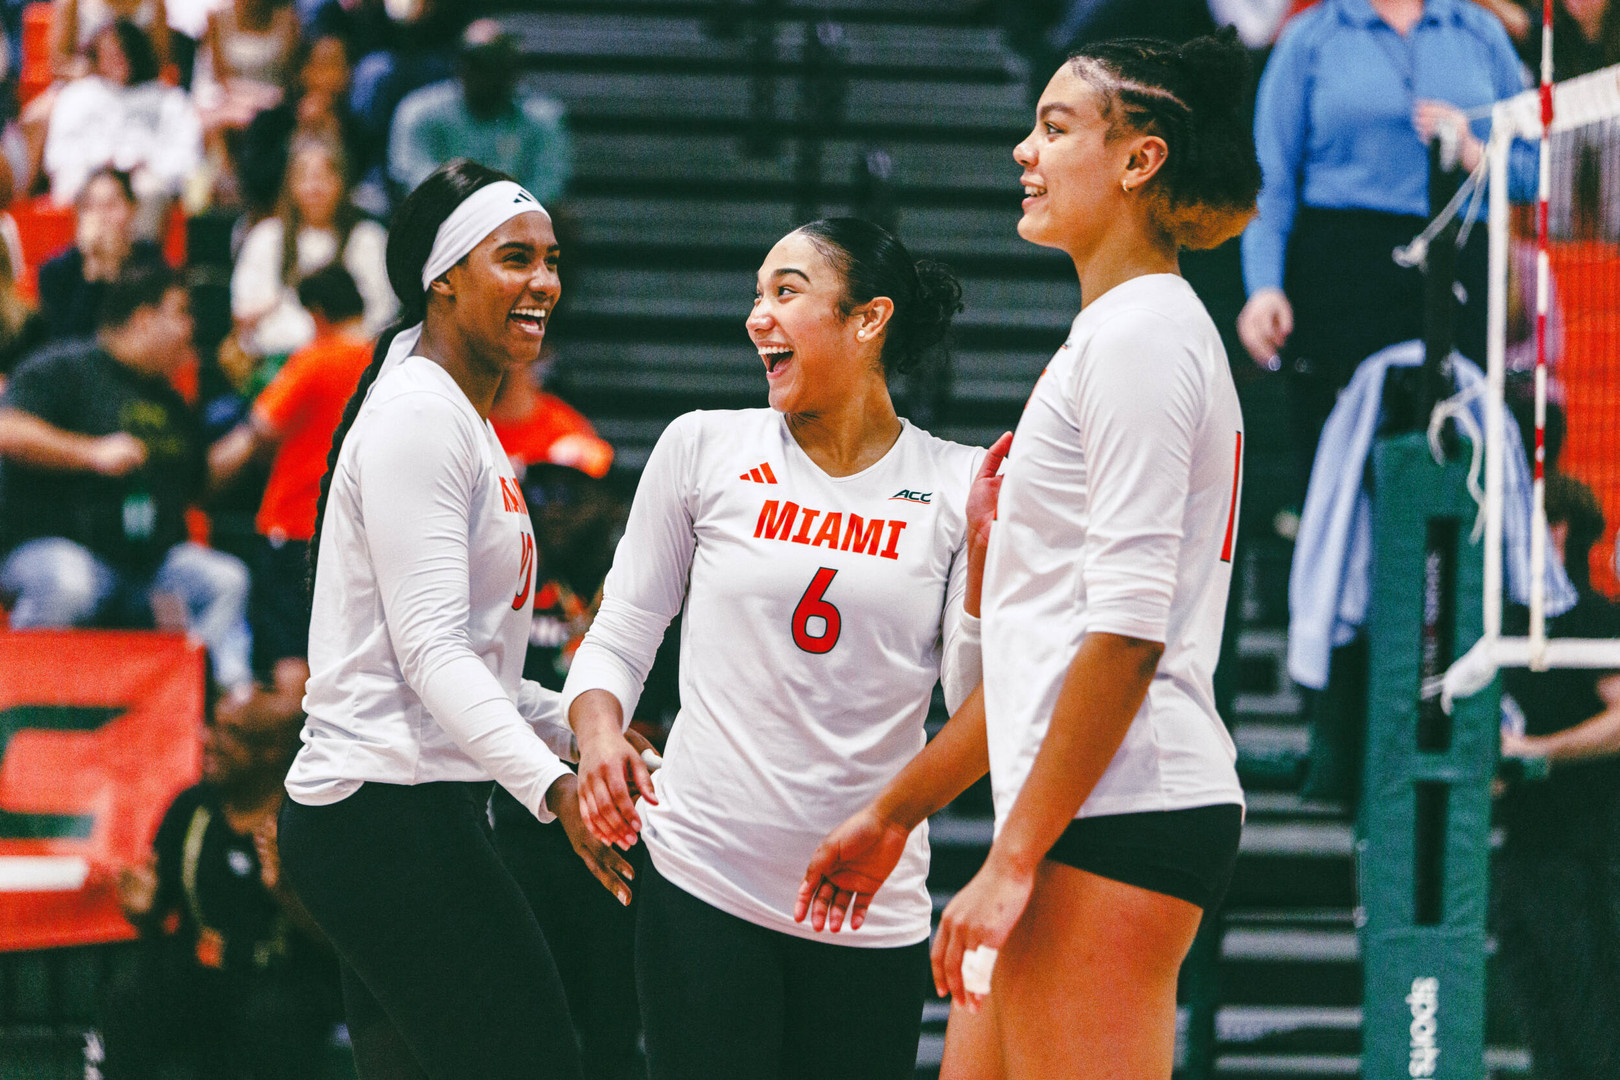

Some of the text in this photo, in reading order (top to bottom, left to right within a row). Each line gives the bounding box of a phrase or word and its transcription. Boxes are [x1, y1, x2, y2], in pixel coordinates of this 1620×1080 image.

[891, 489, 933, 503] ACC
[753, 499, 907, 560] MIAMI
[791, 566, 842, 655] 6
